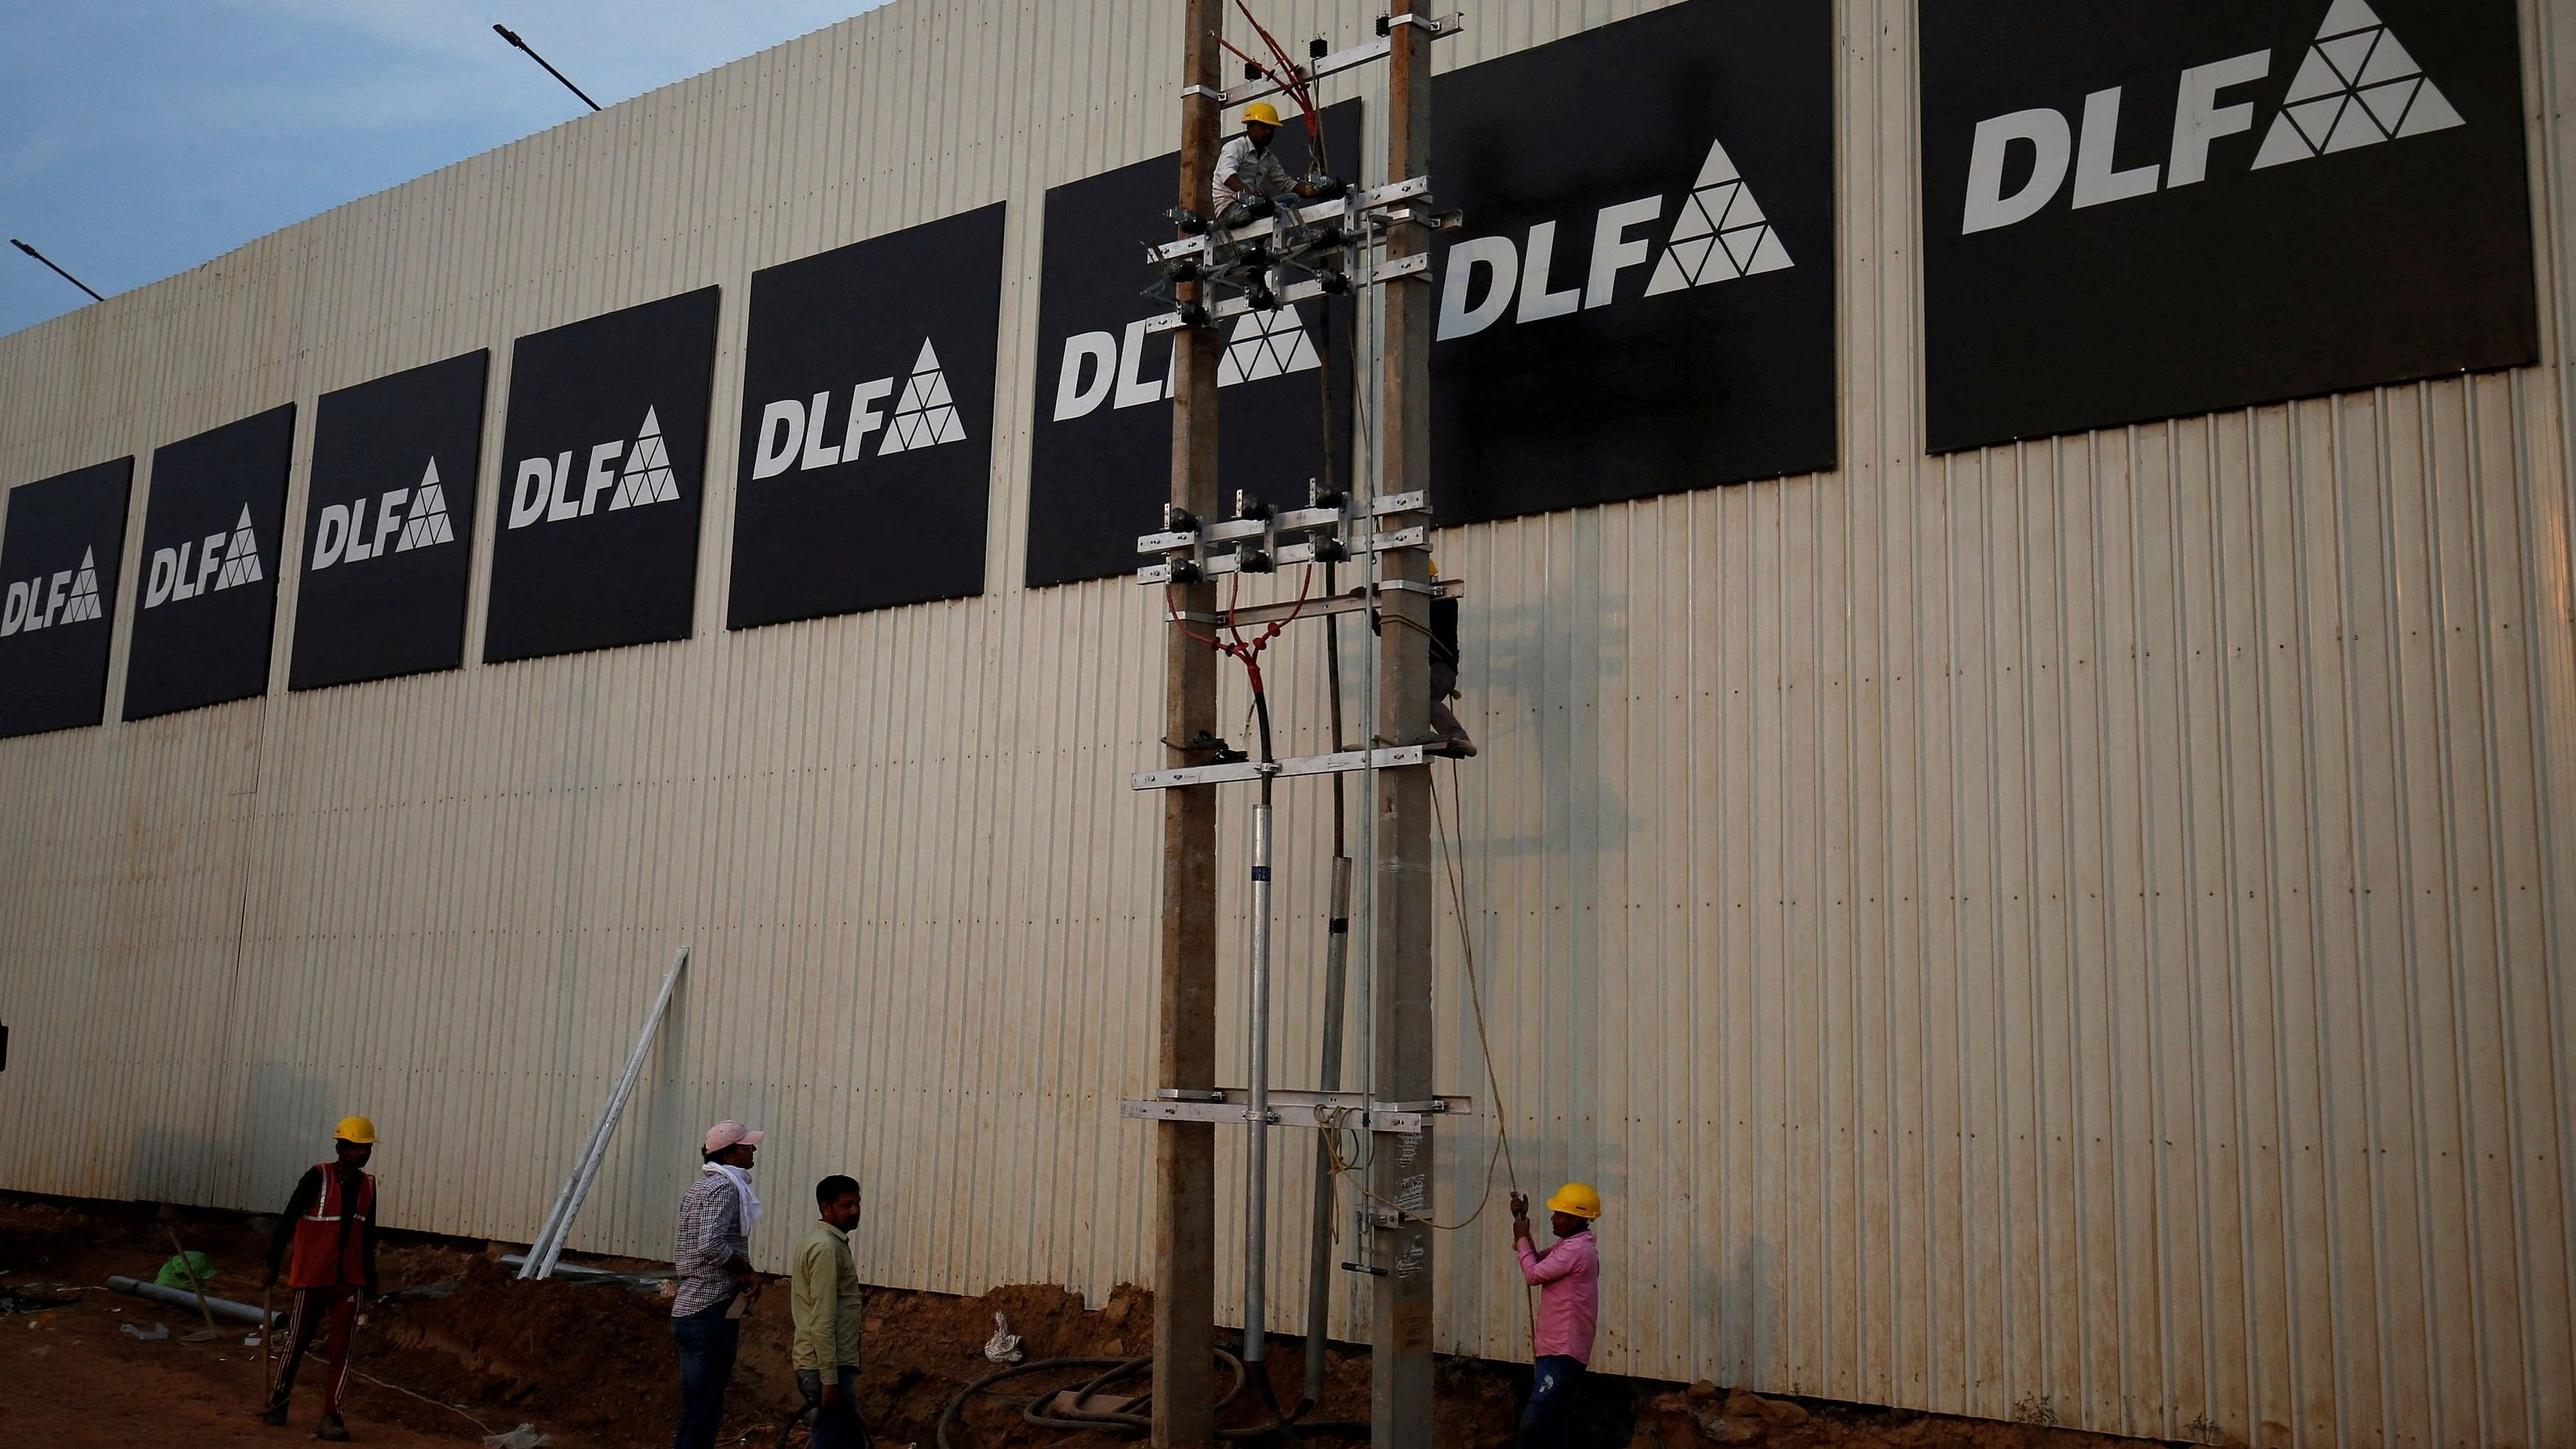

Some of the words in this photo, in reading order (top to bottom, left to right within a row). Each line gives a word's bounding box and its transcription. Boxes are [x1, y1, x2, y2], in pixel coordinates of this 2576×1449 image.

[1962, 49, 2271, 235] DLF
[1437, 194, 1663, 342] DLF
[1053, 319, 1175, 422] DL
[753, 376, 894, 481] DLF
[312, 488, 409, 571] DLF
[509, 440, 624, 530] DLF
[0, 570, 72, 637] DLF
[145, 532, 227, 609] DLF
